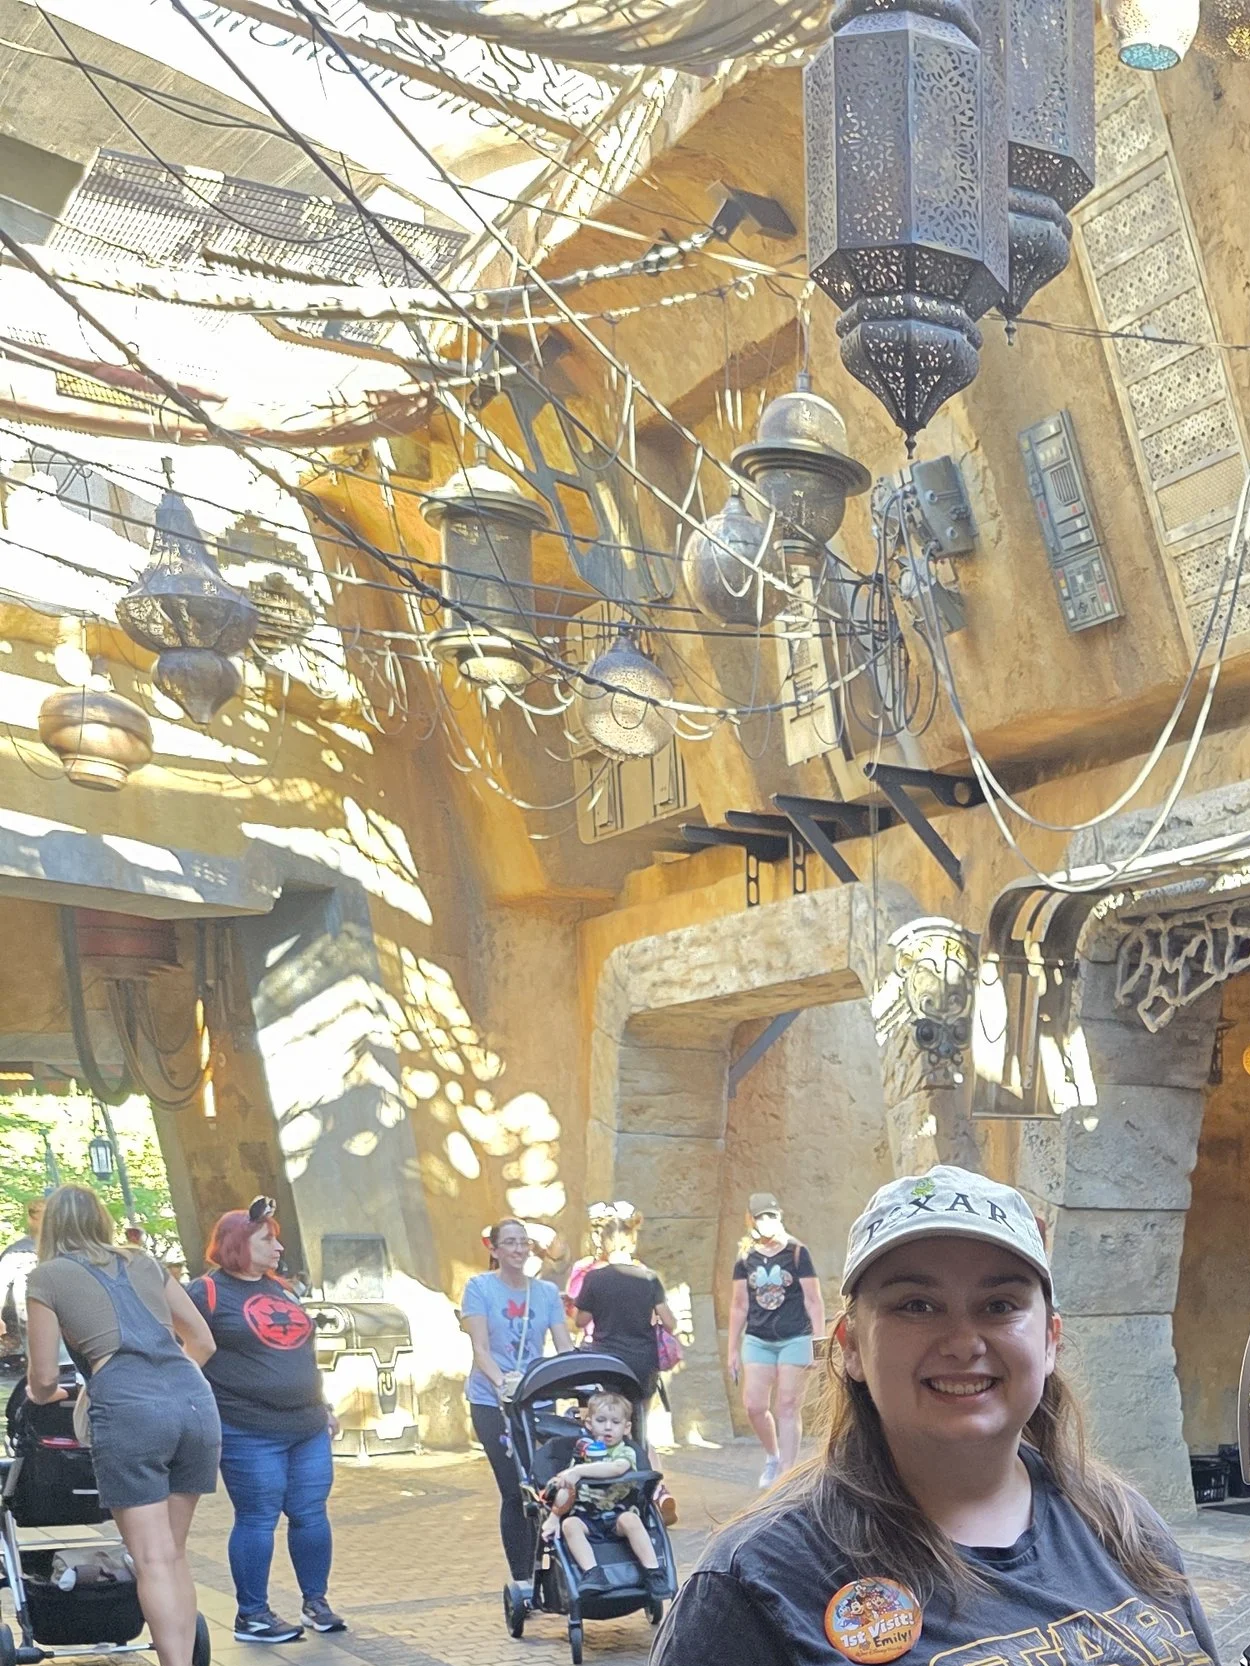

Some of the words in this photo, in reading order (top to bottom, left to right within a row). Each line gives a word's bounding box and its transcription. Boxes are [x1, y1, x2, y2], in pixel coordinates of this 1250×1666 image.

[864, 1192, 1016, 1247] PIXAR
[840, 1633, 867, 1648] 1st
[868, 1613, 914, 1638] Visit!
[873, 1630, 912, 1648] Emily!
